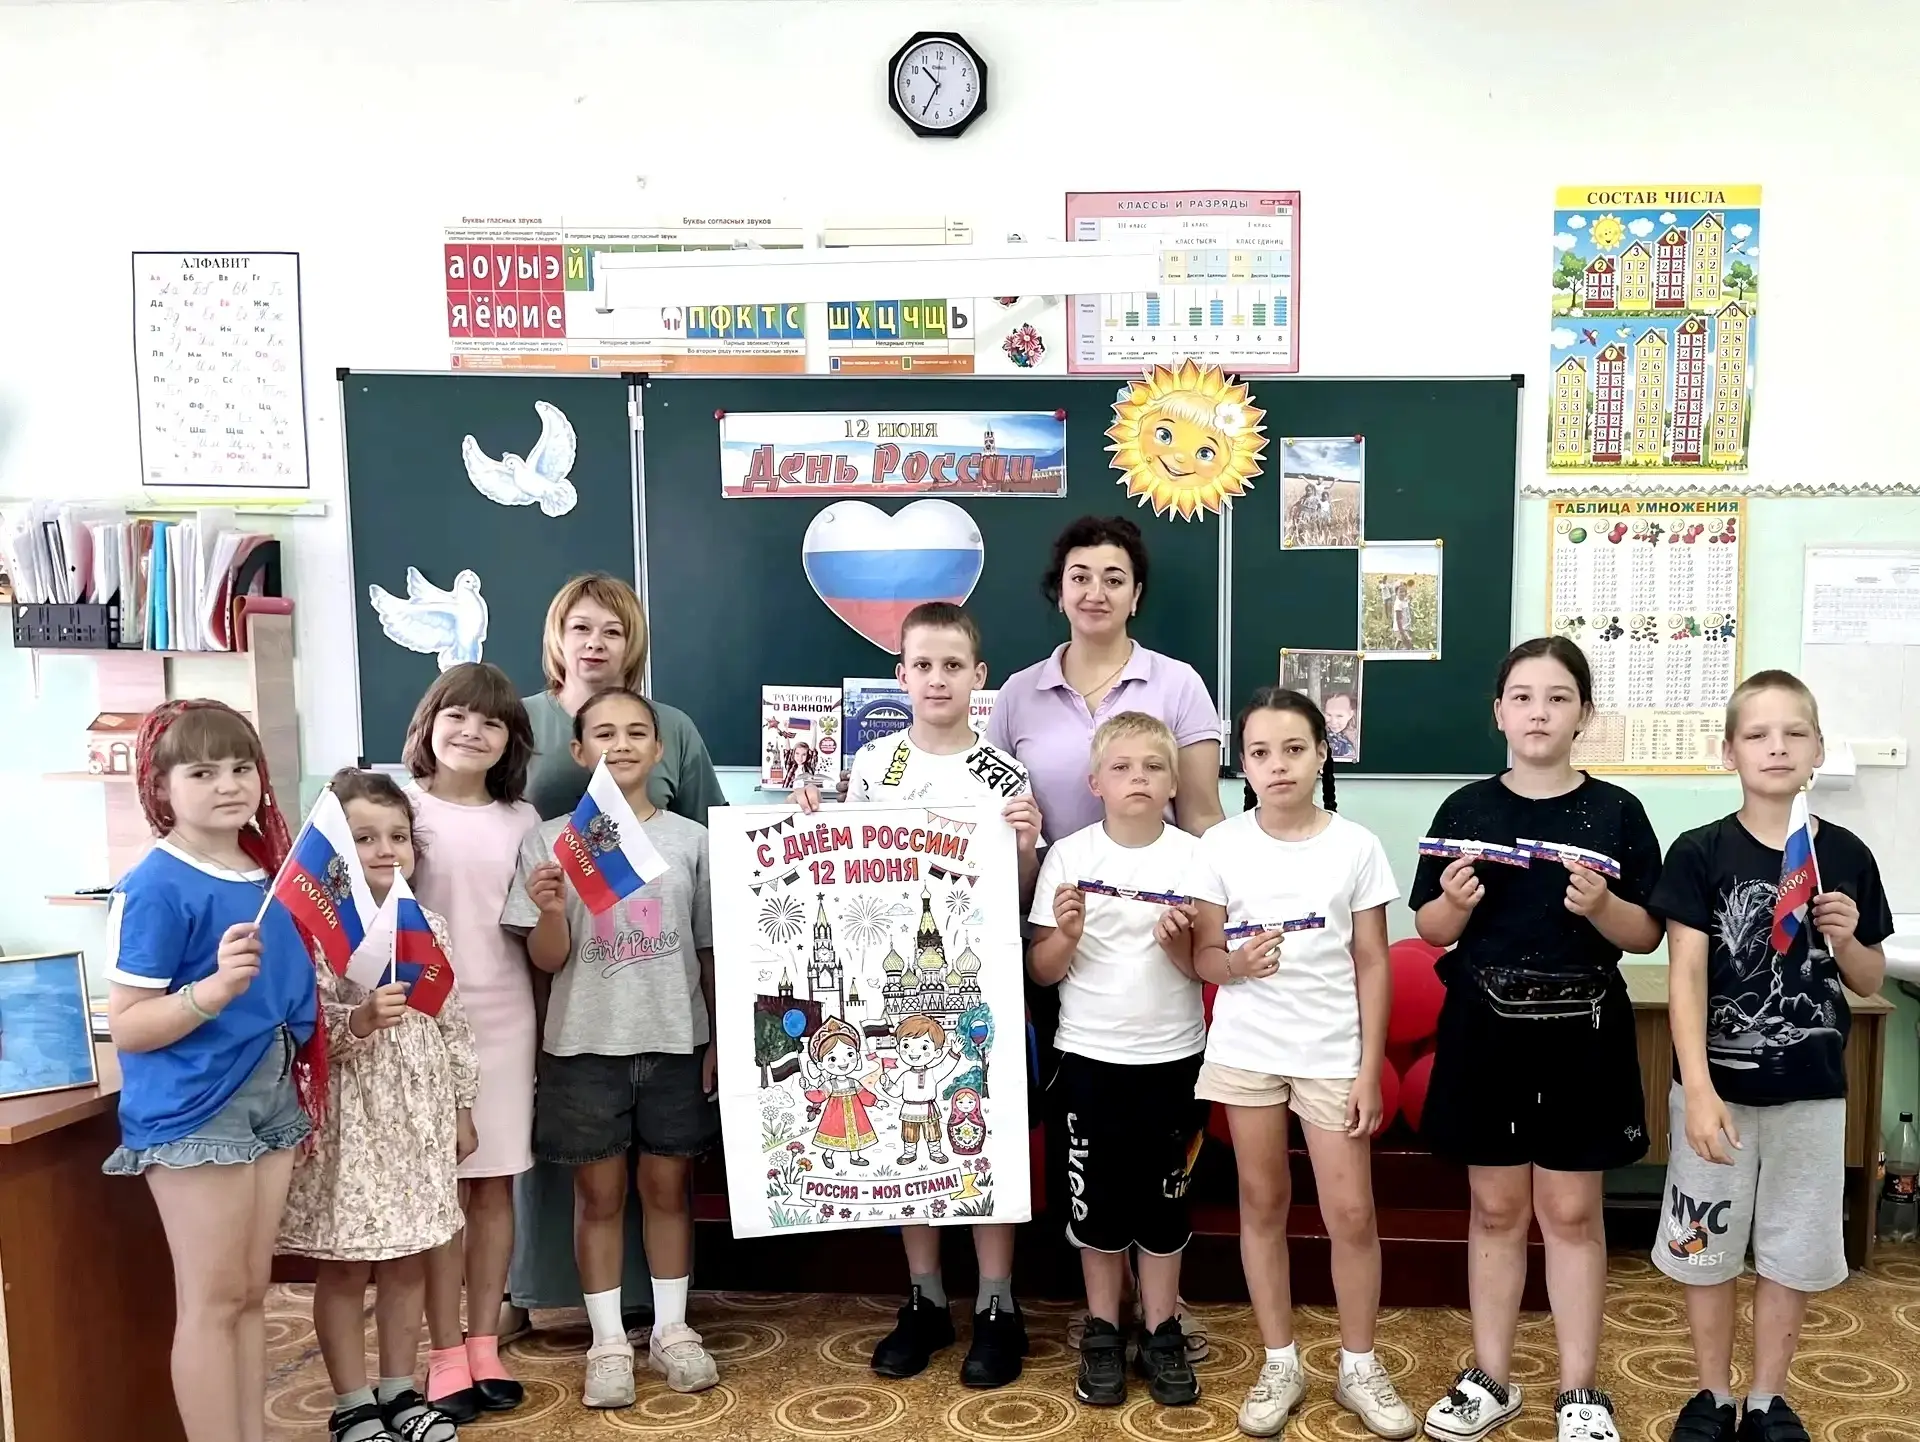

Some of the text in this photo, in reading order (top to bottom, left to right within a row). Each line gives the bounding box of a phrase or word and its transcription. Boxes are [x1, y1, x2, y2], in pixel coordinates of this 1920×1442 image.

[922, 56, 928, 64] 11
[936, 51, 943, 60] 12
[952, 56, 955, 64] 1
[912, 66, 918, 74] 10
[962, 68, 966, 77] 2
[906, 79, 910, 87] 9
[966, 83, 970, 92] 3
[911, 95, 915, 104] 8
[960, 99, 964, 107] 4
[935, 111, 939, 119] 6
[949, 108, 953, 117] 5
[1588, 191, 1726, 204] СОСТАВ ЧИСЛА
[1118, 201, 1169, 210] КЛАССЫ
[1190, 200, 1248, 208] РАЗРЯДЫ
[462, 216, 485, 224] Буквы
[1705, 219, 1711, 229] 5
[1669, 234, 1675, 243] 4
[1633, 248, 1640, 257] 3
[1698, 248, 1716, 256] 2 3
[181, 258, 250, 269] АЛФАВИТ
[450, 248, 583, 287] а о у ы э й
[1598, 261, 1604, 270] 2
[1639, 262, 1645, 270] 2
[1698, 261, 1716, 269] 3 2
[1697, 275, 1703, 283] 4
[1626, 289, 1644, 297] 3 0
[1696, 288, 1715, 296] 5 0
[452, 297, 562, 328] я ё ю и е
[1728, 308, 1738, 317] 10
[689, 305, 798, 338] п ф к т с
[829, 306, 968, 334] ш х ц ч щ ь
[1689, 322, 1694, 331] 9
[1648, 335, 1654, 343] 8
[1609, 350, 1614, 358] 7
[1568, 362, 1574, 371] 6
[844, 420, 869, 438] 12
[742, 442, 1036, 492] День России
[1556, 502, 1739, 515] ТАБЛИЦА УМНОЖЕНИЯ
[773, 693, 832, 703] РАЗГОВОРЫ
[783, 704, 832, 712] ВАЖНОМ
[757, 823, 969, 867] С ДНЁМ РОССИИ!
[563, 826, 596, 877] РОССИЯ
[809, 858, 919, 885] 12 ИЮНЯ
[292, 873, 339, 930] РОССИЯ
[581, 930, 625, 964] Girl
[1067, 1112, 1089, 1222] Likee
[806, 1181, 859, 1200] РОССИЯ
[872, 1184, 901, 1200] МОЯ
[904, 1176, 959, 1198] СТРАНА!
[1672, 1184, 1732, 1234] NYC
[1688, 1251, 1726, 1266] BEST
